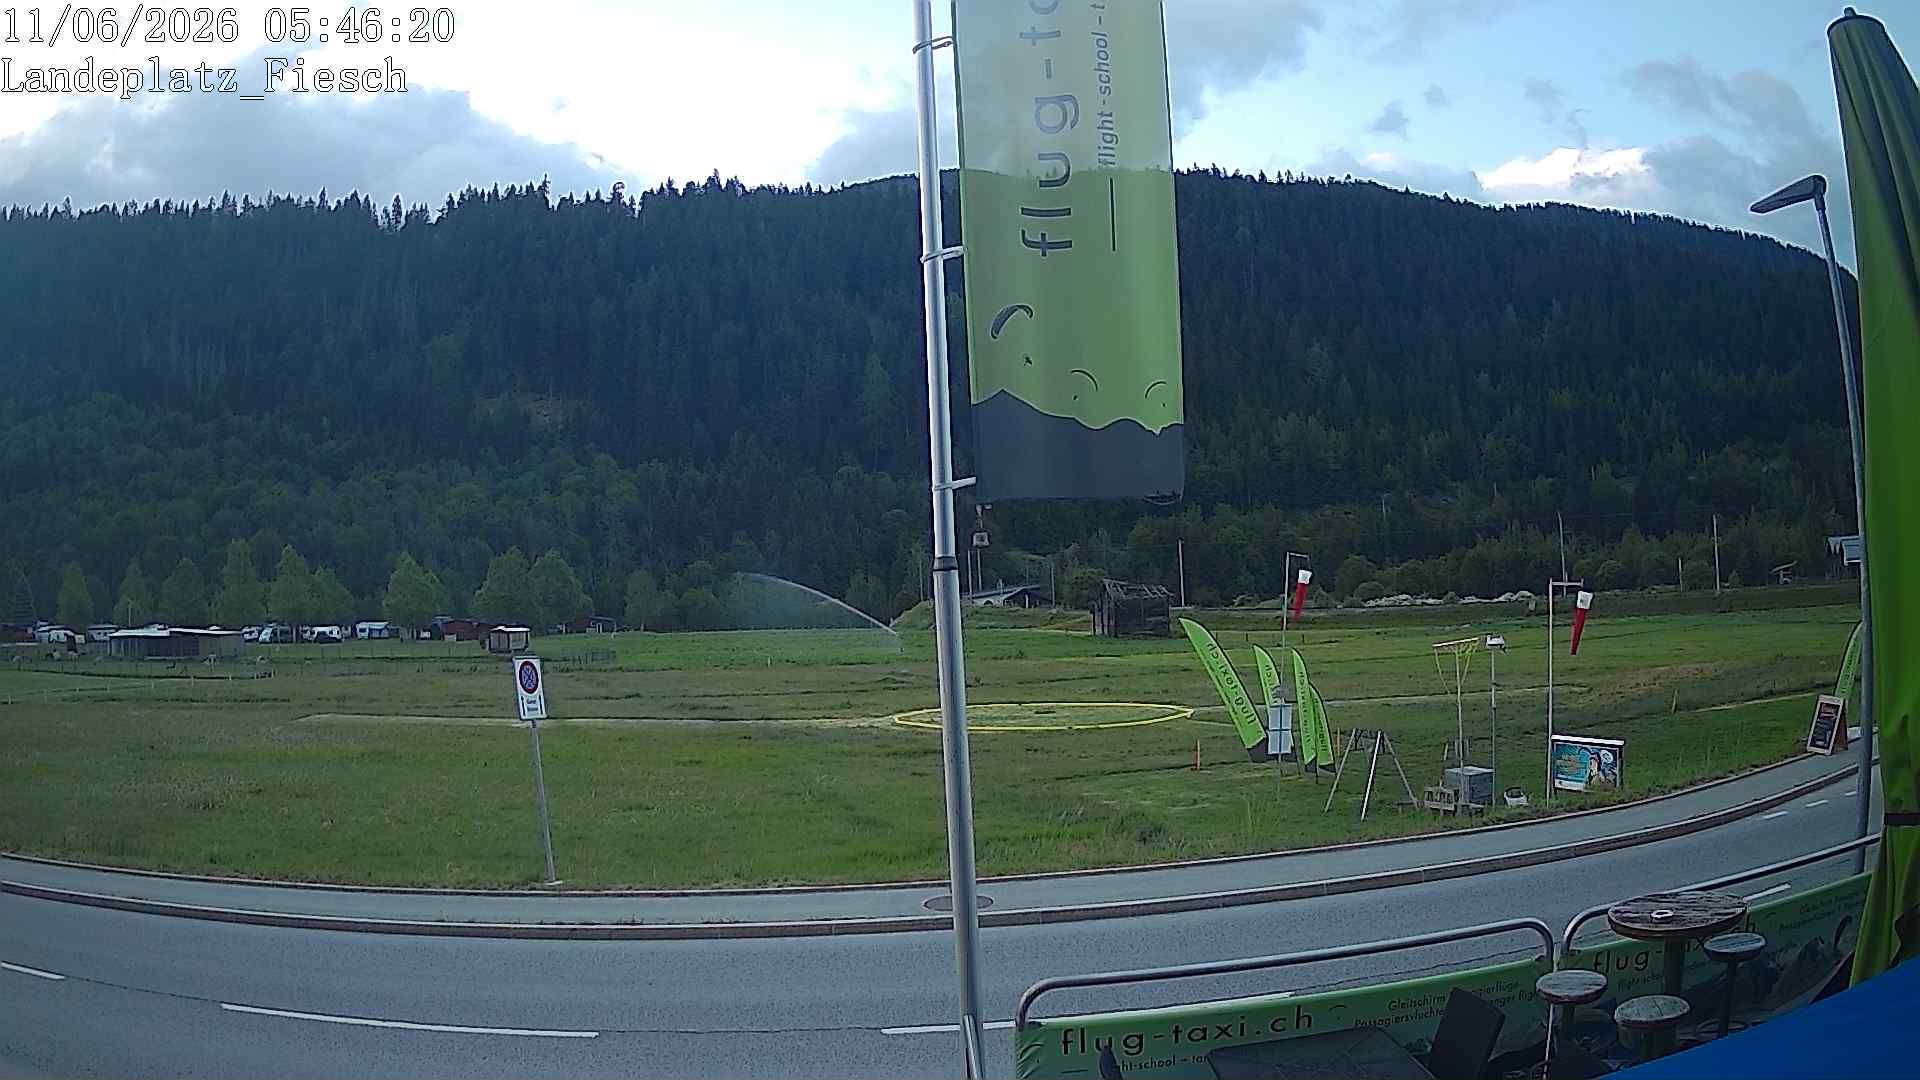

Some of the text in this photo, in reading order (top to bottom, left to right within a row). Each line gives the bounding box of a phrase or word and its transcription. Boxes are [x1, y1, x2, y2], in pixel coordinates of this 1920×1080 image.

[1388, 994, 1446, 1012] Gleitschirm
[1354, 1007, 1446, 1028] Passagiersvluchte
[1062, 1005, 1313, 1056] flug-taxi.ch
[1120, 1056, 1176, 1071] ht-school
